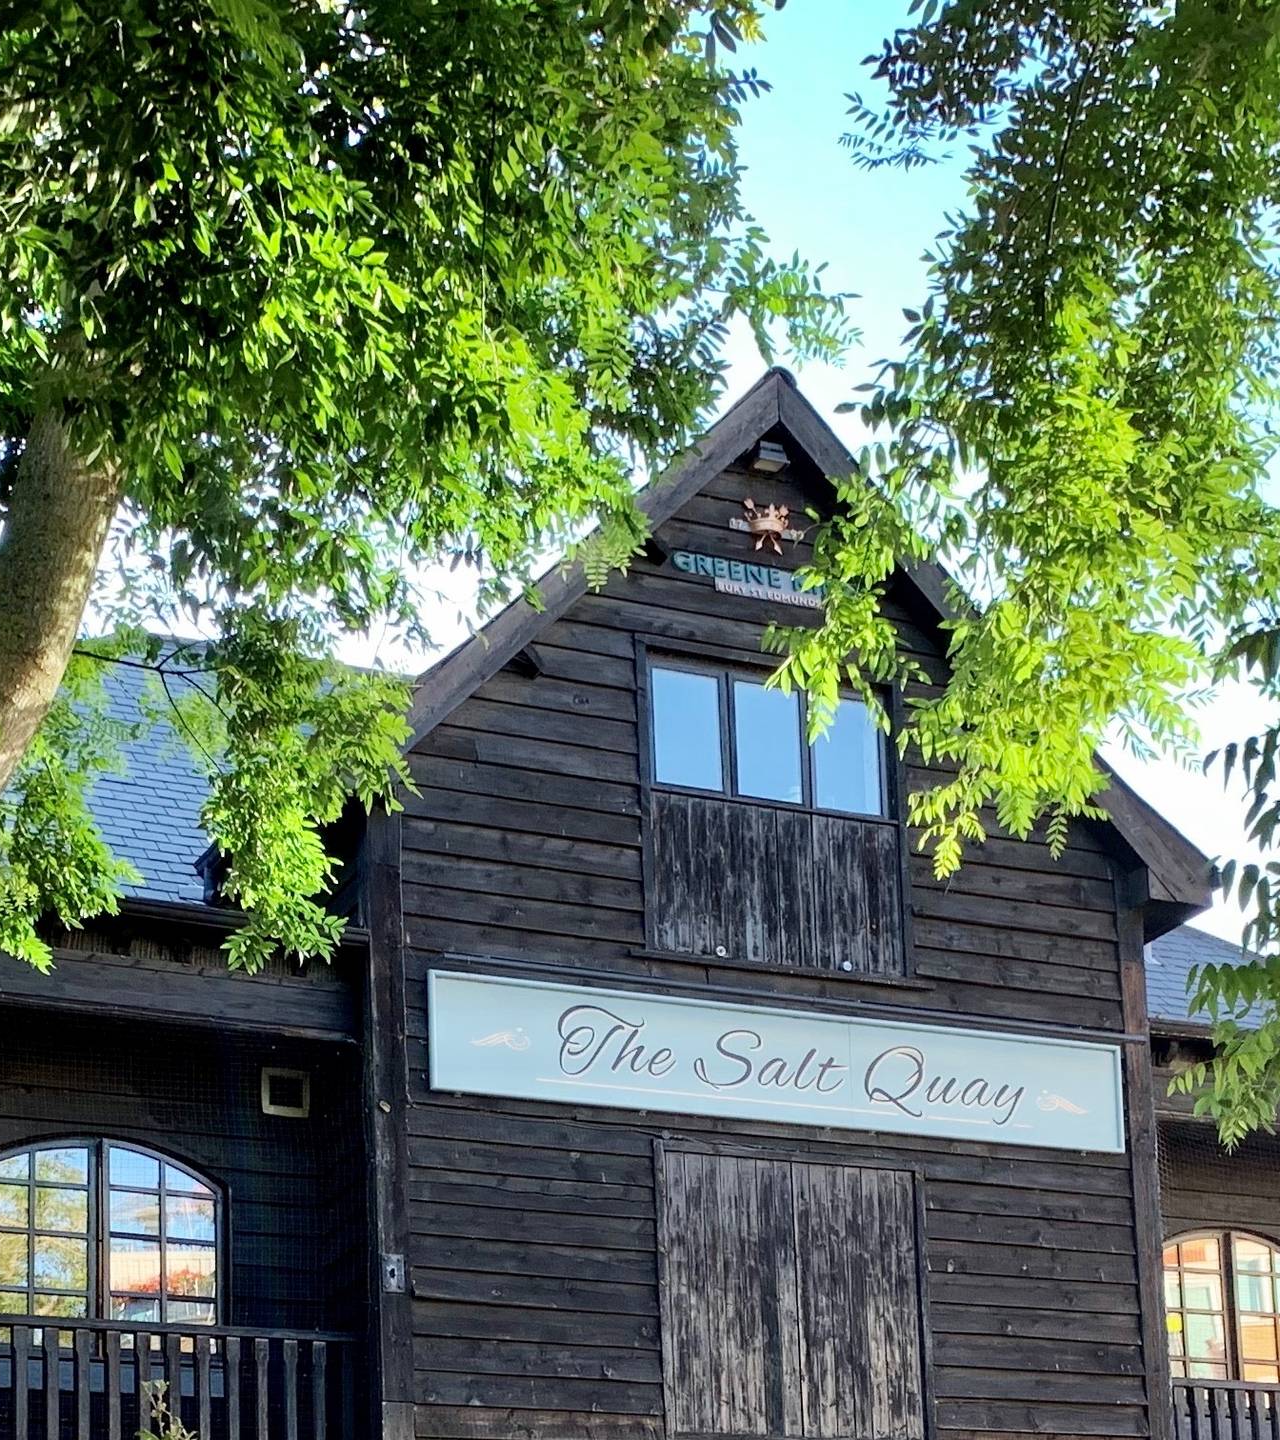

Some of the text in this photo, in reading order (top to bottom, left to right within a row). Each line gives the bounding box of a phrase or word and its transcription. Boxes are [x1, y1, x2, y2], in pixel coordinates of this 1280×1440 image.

[672, 551, 781, 588] GREENE
[716, 583, 746, 595] BURY
[557, 1004, 1025, 1126] The Salt Quay
